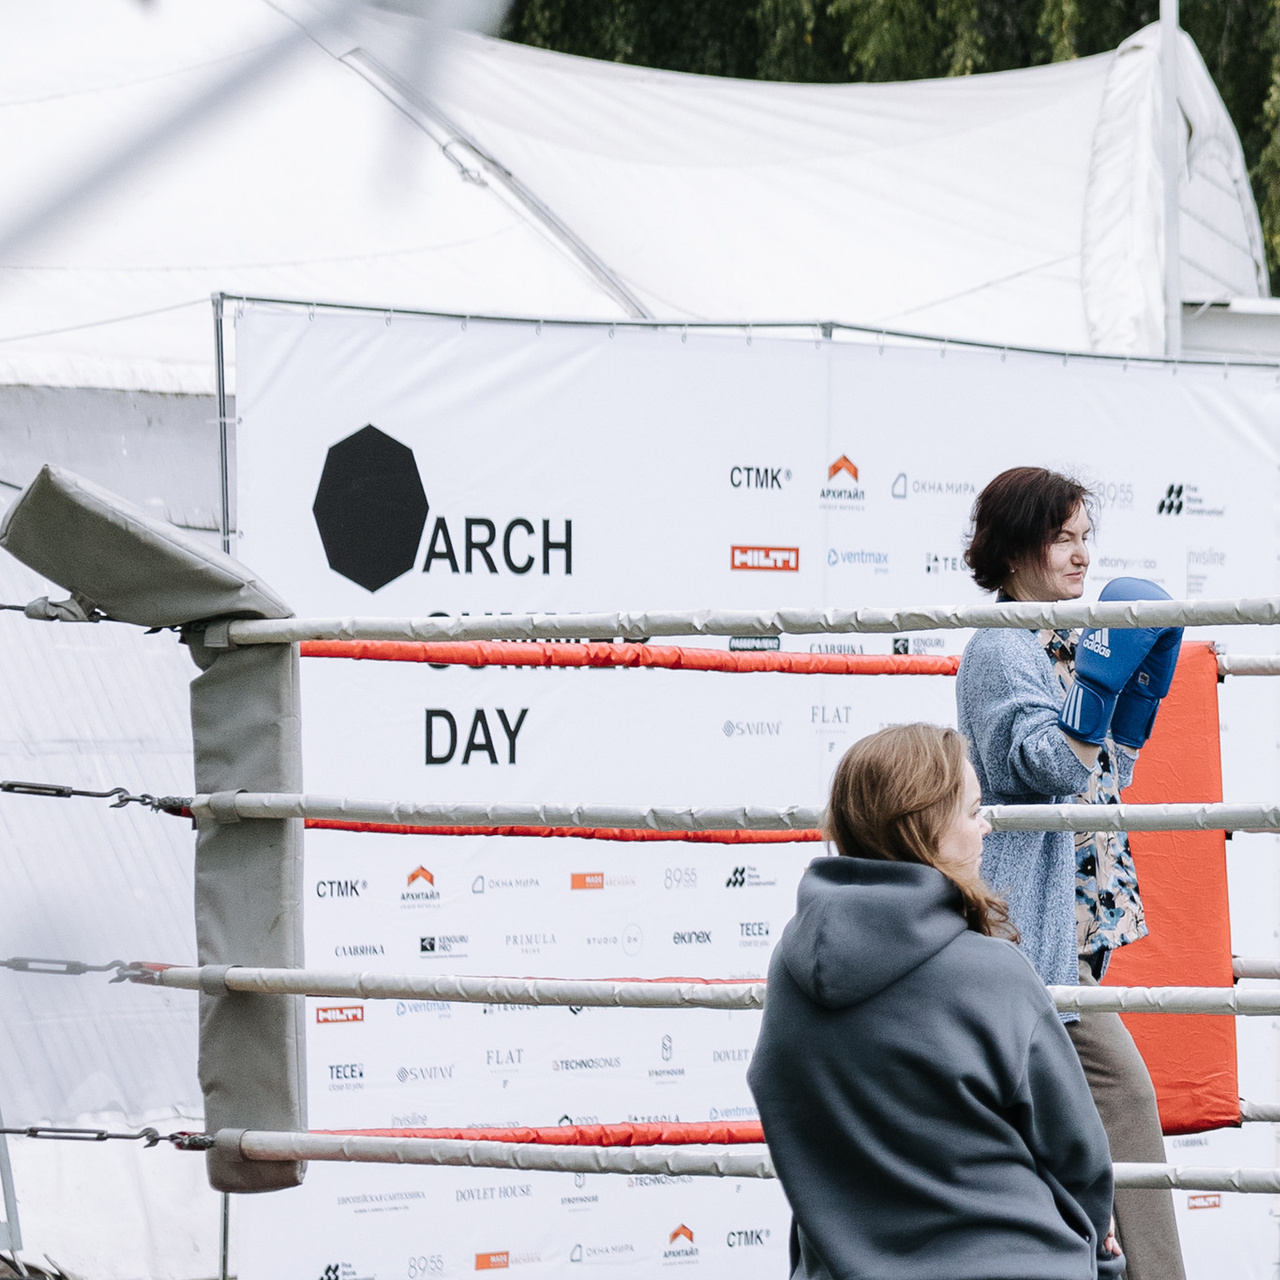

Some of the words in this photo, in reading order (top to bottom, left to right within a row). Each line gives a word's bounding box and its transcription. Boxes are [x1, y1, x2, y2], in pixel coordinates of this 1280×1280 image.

[819, 486, 865, 501] АРХИТАЙЛ
[422, 516, 574, 575] ARCH
[733, 549, 796, 569] HILTI
[840, 550, 889, 565] ventmax
[1083, 638, 1112, 658] adidas
[810, 705, 852, 724] FLAT
[425, 707, 529, 765] DAY
[400, 890, 441, 901] АРХИТАЙЛ
[505, 933, 557, 946] PRIMULA
[673, 930, 712, 945] ekinex
[318, 1008, 362, 1022] HILTI
[486, 1048, 524, 1065] FLAT
[560, 1056, 621, 1071] TECHNOSONUS
[713, 1050, 748, 1063] DOVLET
[328, 1064, 358, 1080] TECE
[455, 1186, 496, 1202] DOVLET
[499, 1184, 532, 1199] HOUSE
